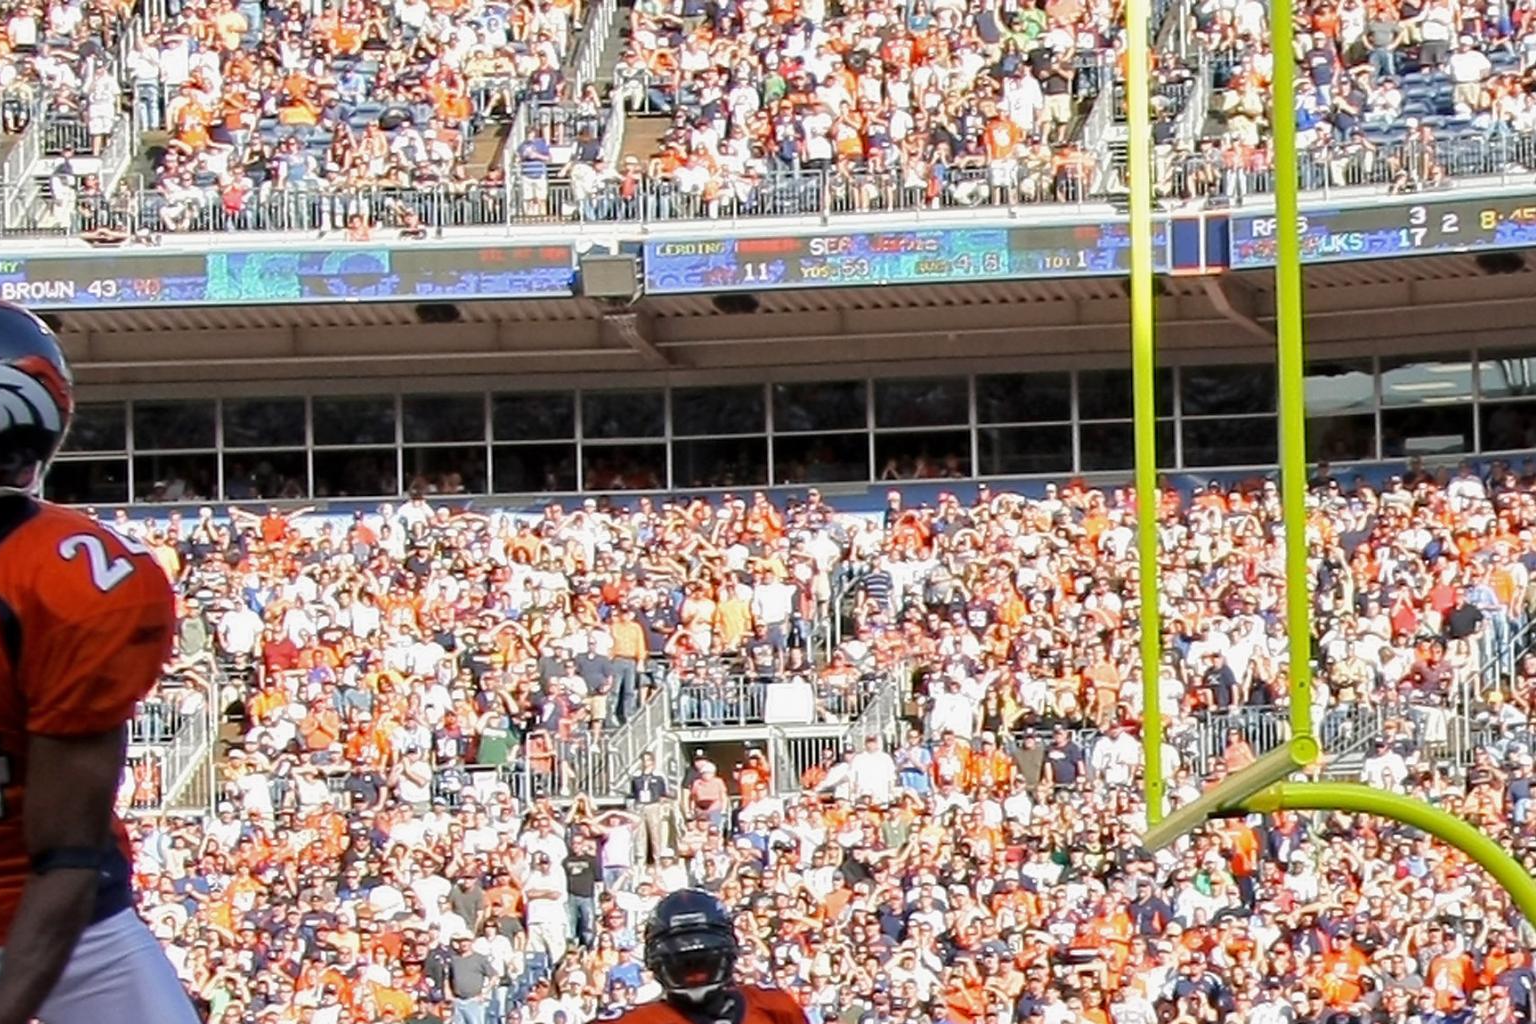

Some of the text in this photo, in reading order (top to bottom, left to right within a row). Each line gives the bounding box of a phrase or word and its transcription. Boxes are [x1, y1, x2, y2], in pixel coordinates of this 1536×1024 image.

[1410, 206, 1427, 225] 3
[1442, 214, 1459, 233] 2
[1399, 227, 1426, 247] 17
[1, 281, 75, 300] BROWN
[87, 279, 116, 298] 43
